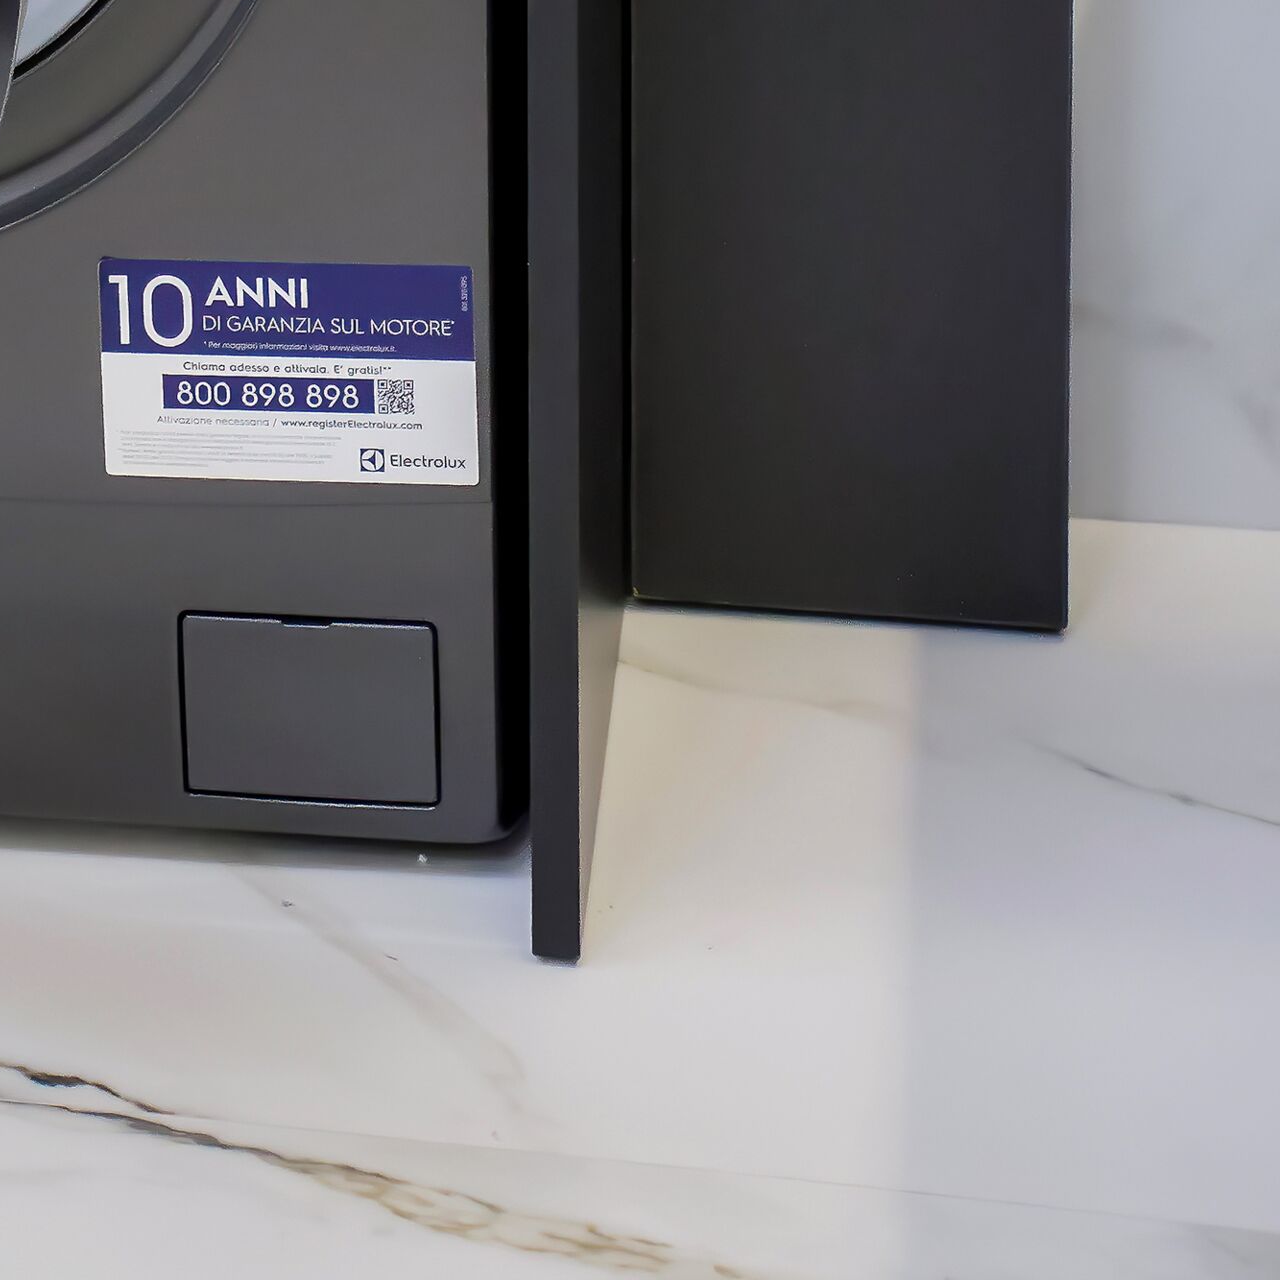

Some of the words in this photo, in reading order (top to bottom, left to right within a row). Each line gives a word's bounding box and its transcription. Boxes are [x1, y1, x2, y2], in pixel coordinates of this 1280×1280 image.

[205, 276, 308, 309] ANNI
[108, 274, 193, 348] 10
[202, 315, 221, 333] DI
[226, 315, 325, 335] GARANZIA
[331, 318, 365, 335] SUL
[183, 361, 226, 372] Chiama
[229, 362, 271, 373] adesso
[273, 365, 280, 373] e
[177, 381, 230, 406] 800
[241, 382, 295, 408] 898
[306, 384, 360, 409] 898
[157, 415, 213, 425] Attivazione
[281, 419, 423, 431] www.registerElectrolux.com
[390, 454, 466, 470] Electrolux
